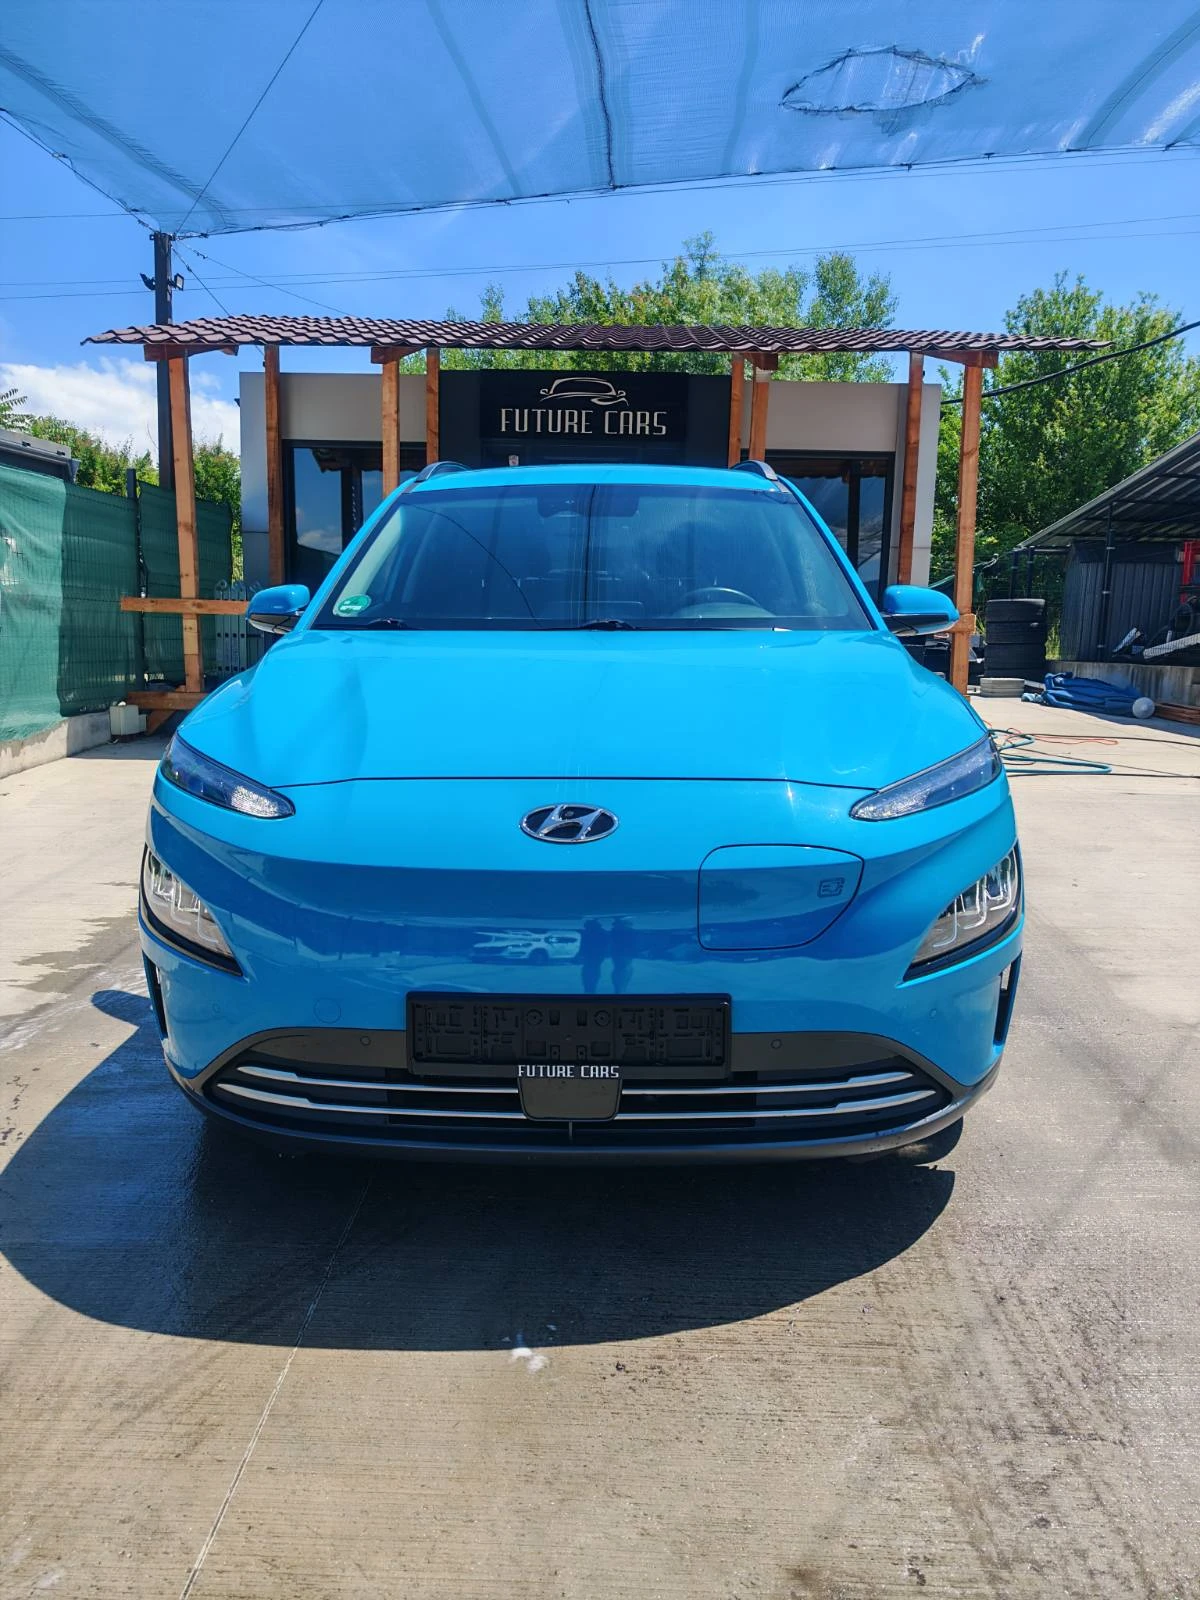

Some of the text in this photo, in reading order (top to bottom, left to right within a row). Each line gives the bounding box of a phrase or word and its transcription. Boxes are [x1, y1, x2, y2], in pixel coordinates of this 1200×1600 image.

[501, 408, 668, 436] FUTURE CARS
[518, 1064, 620, 1079] FUTURE CARS
